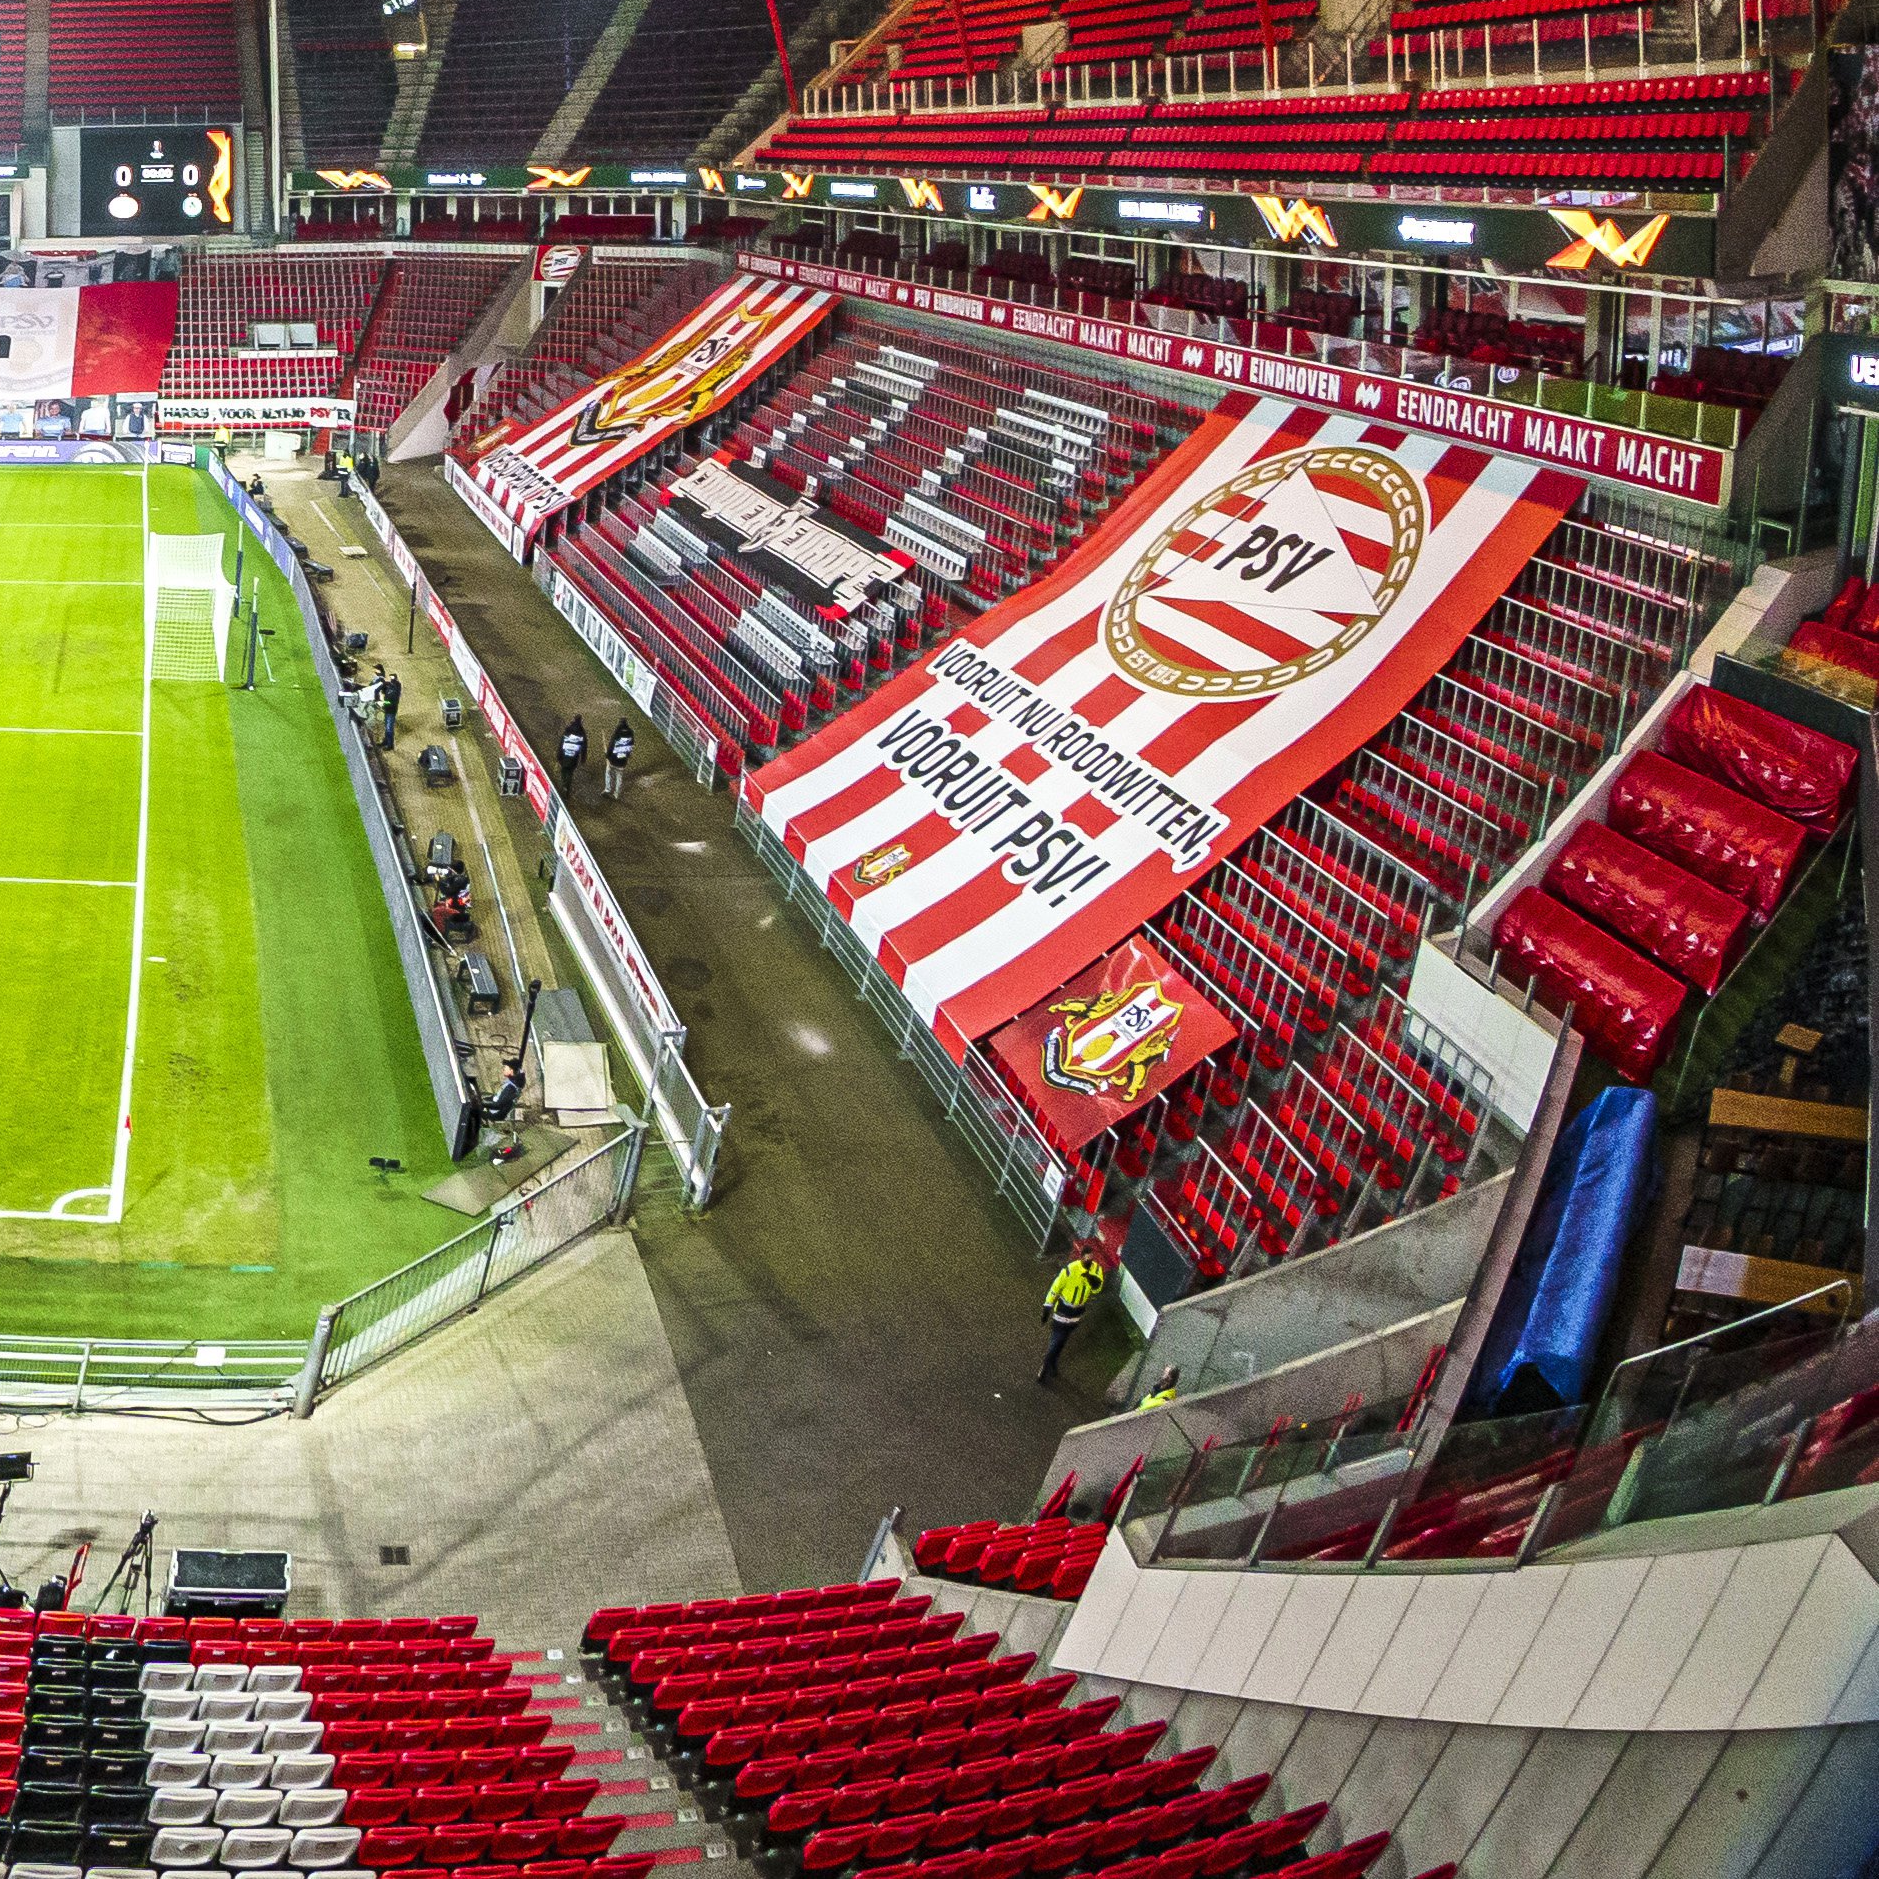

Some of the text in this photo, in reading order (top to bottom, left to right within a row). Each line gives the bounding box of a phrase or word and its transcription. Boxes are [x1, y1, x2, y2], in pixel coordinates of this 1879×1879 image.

[116, 166, 131, 187] 0
[183, 165, 198, 186] 0
[219, 407, 257, 419] VOOR
[1013, 308, 1075, 341] EENDRACHT
[1079, 322, 1122, 352] MAAKT
[1127, 332, 1172, 363] MACHT
[1214, 350, 1244, 379] PSV
[1249, 356, 1342, 403] EINDHOVEN
[1397, 387, 1514, 444] EENDRACHT
[1523, 416, 1605, 467] MAAKT
[1616, 435, 1703, 492] MACHT
[1212, 524, 1336, 593] PSV
[933, 643, 1221, 866] VOORUIT NU ROODWITTEN,
[876, 709, 1111, 909] VOORUIT PSV!
[1120, 1004, 1153, 1033] PSV
